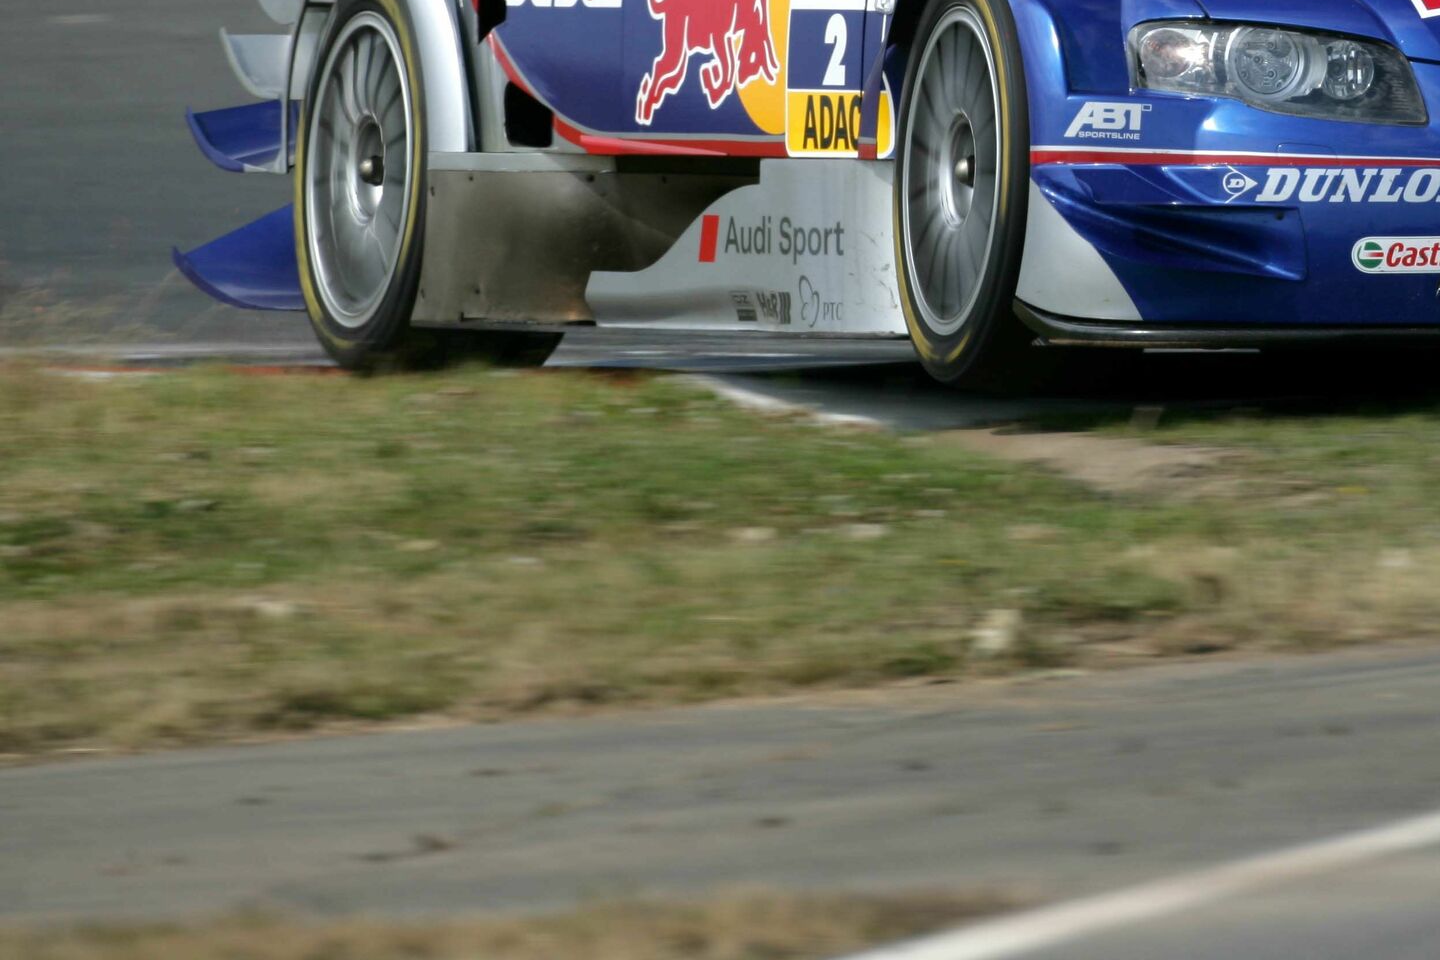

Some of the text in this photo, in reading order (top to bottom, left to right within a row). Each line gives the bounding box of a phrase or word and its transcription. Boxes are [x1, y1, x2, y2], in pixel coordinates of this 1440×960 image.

[822, 14, 848, 86] 2
[802, 94, 862, 151] ADAC
[1064, 101, 1142, 137] ABT
[1078, 131, 1141, 140] SPORTSLINE
[725, 216, 844, 265] Audi Sport
[823, 302, 843, 321] PTC
